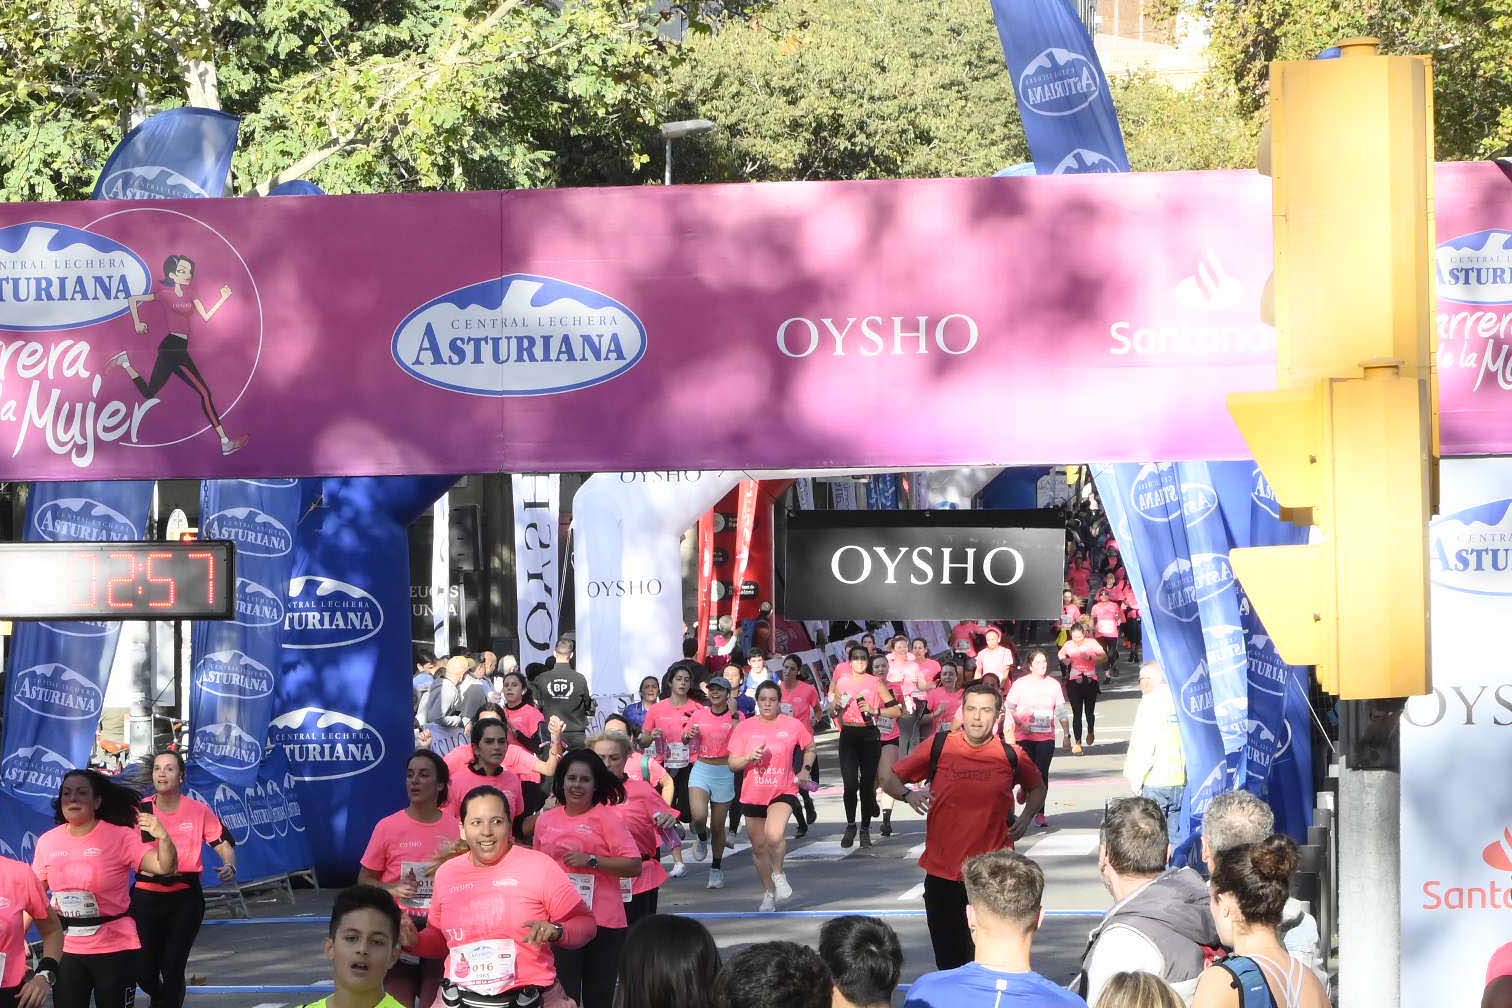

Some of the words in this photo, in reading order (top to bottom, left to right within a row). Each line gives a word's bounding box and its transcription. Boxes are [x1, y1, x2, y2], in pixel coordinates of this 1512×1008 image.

[55, 257, 125, 269] LECHERA
[451, 318, 530, 331] CENTRAL
[538, 315, 618, 328] LECHERA
[777, 314, 978, 358] OYSHO
[413, 322, 626, 366] ASTURIANA
[12, 374, 161, 467] Mujer
[210, 519, 286, 550] ASTURIANA
[831, 545, 1025, 586] OYSHO
[587, 577, 663, 599] OYSHO
[198, 669, 268, 693] ASTURIANA
[553, 683, 568, 693] BP
[14, 683, 96, 713] ASTURIANA
